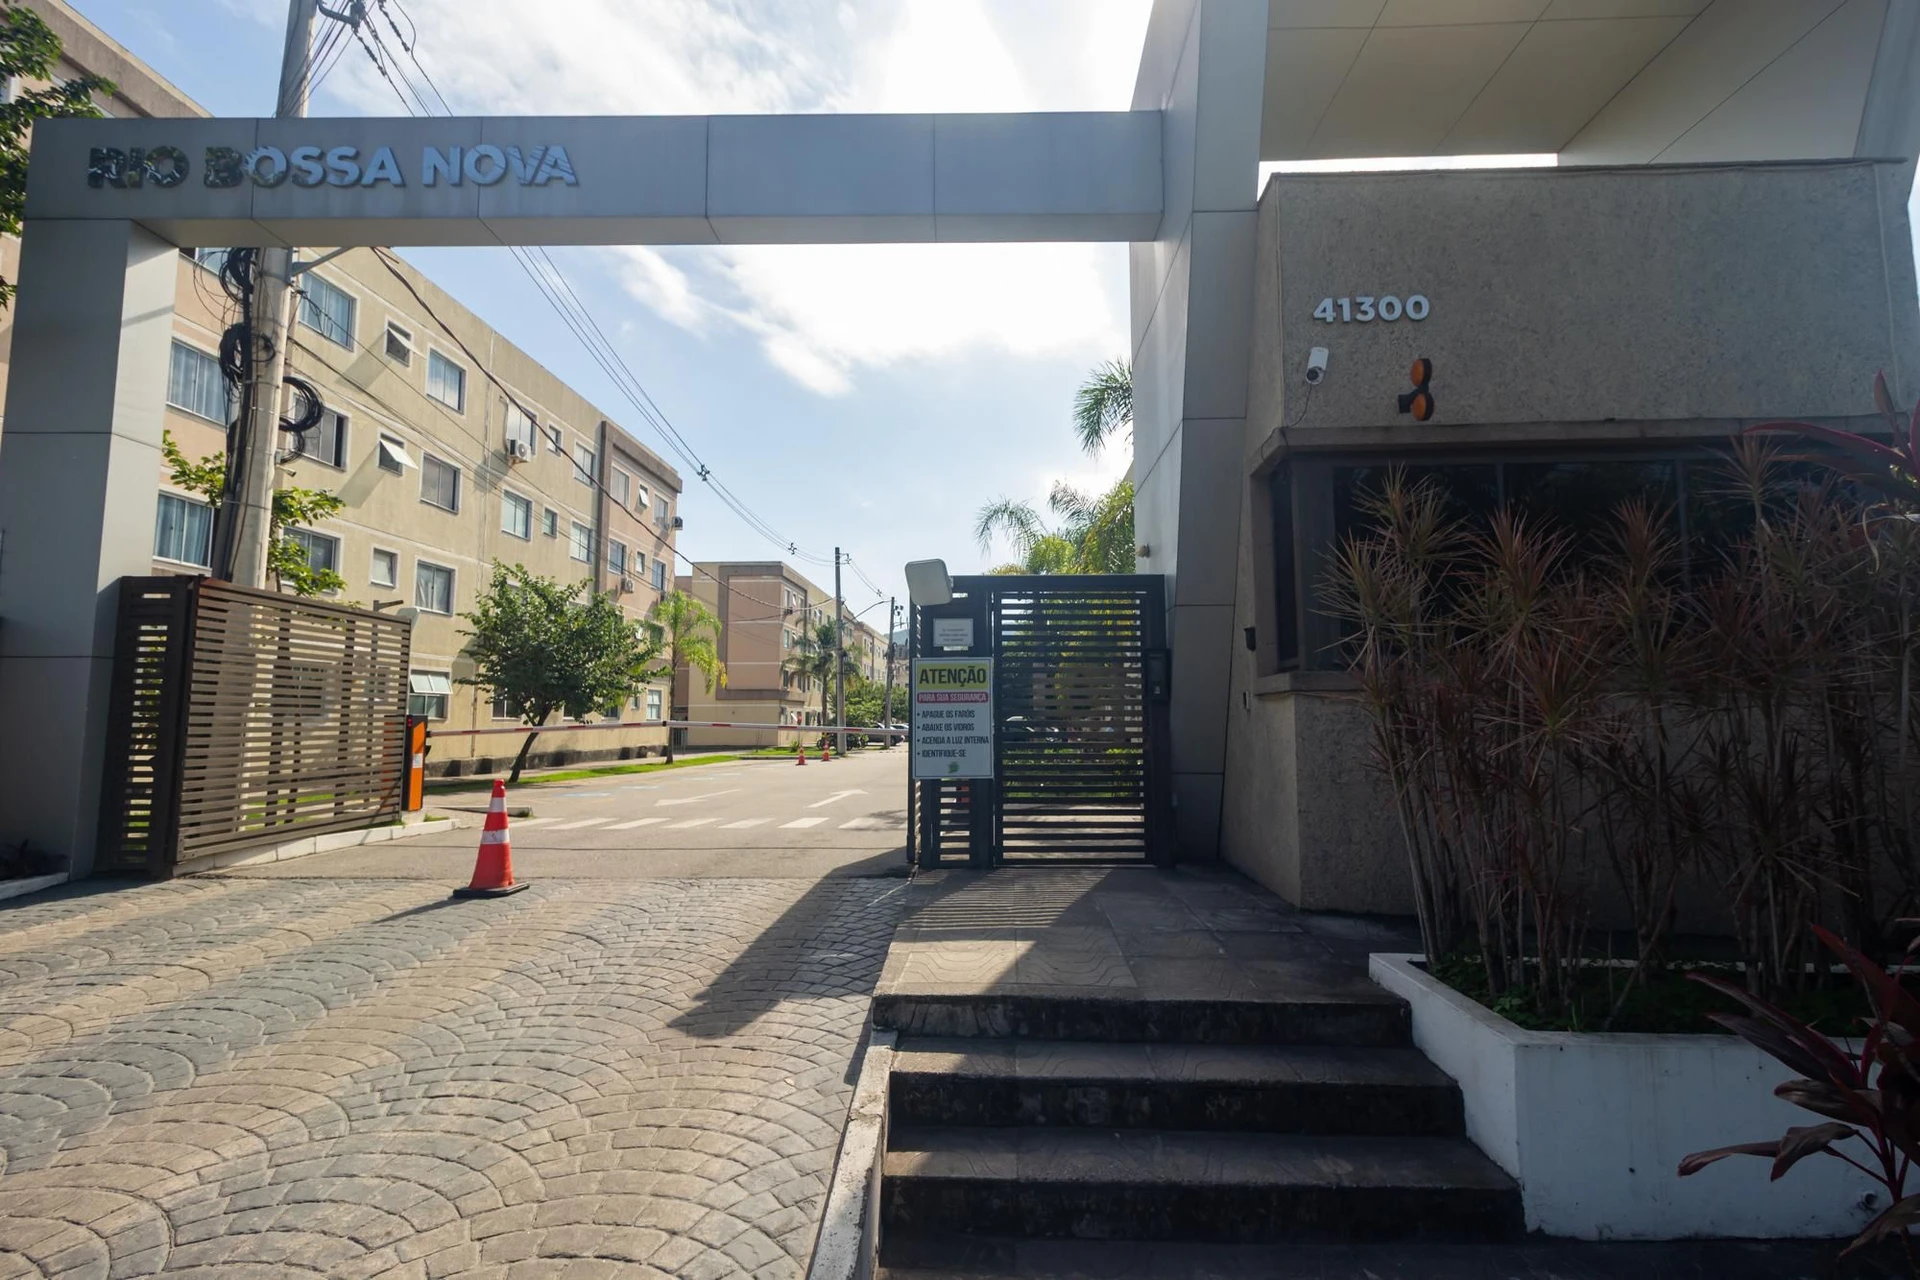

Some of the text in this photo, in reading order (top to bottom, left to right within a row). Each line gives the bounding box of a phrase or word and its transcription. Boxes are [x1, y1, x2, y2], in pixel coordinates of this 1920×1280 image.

[87, 144, 578, 189] RIO BOSSA NOVA
[1313, 294, 1430, 323] 41300
[919, 665, 987, 687] ATENÇÃO
[919, 693, 987, 702] PARA SUA SEGURANÇA
[921, 709, 975, 718] APAGUE OS FARÓIS
[921, 723, 975, 731] ABAIXE OS VIDROS
[921, 736, 989, 744] ACENDA A LUZ INTERNA
[921, 749, 967, 757] IDENTIFIQUE-SE
